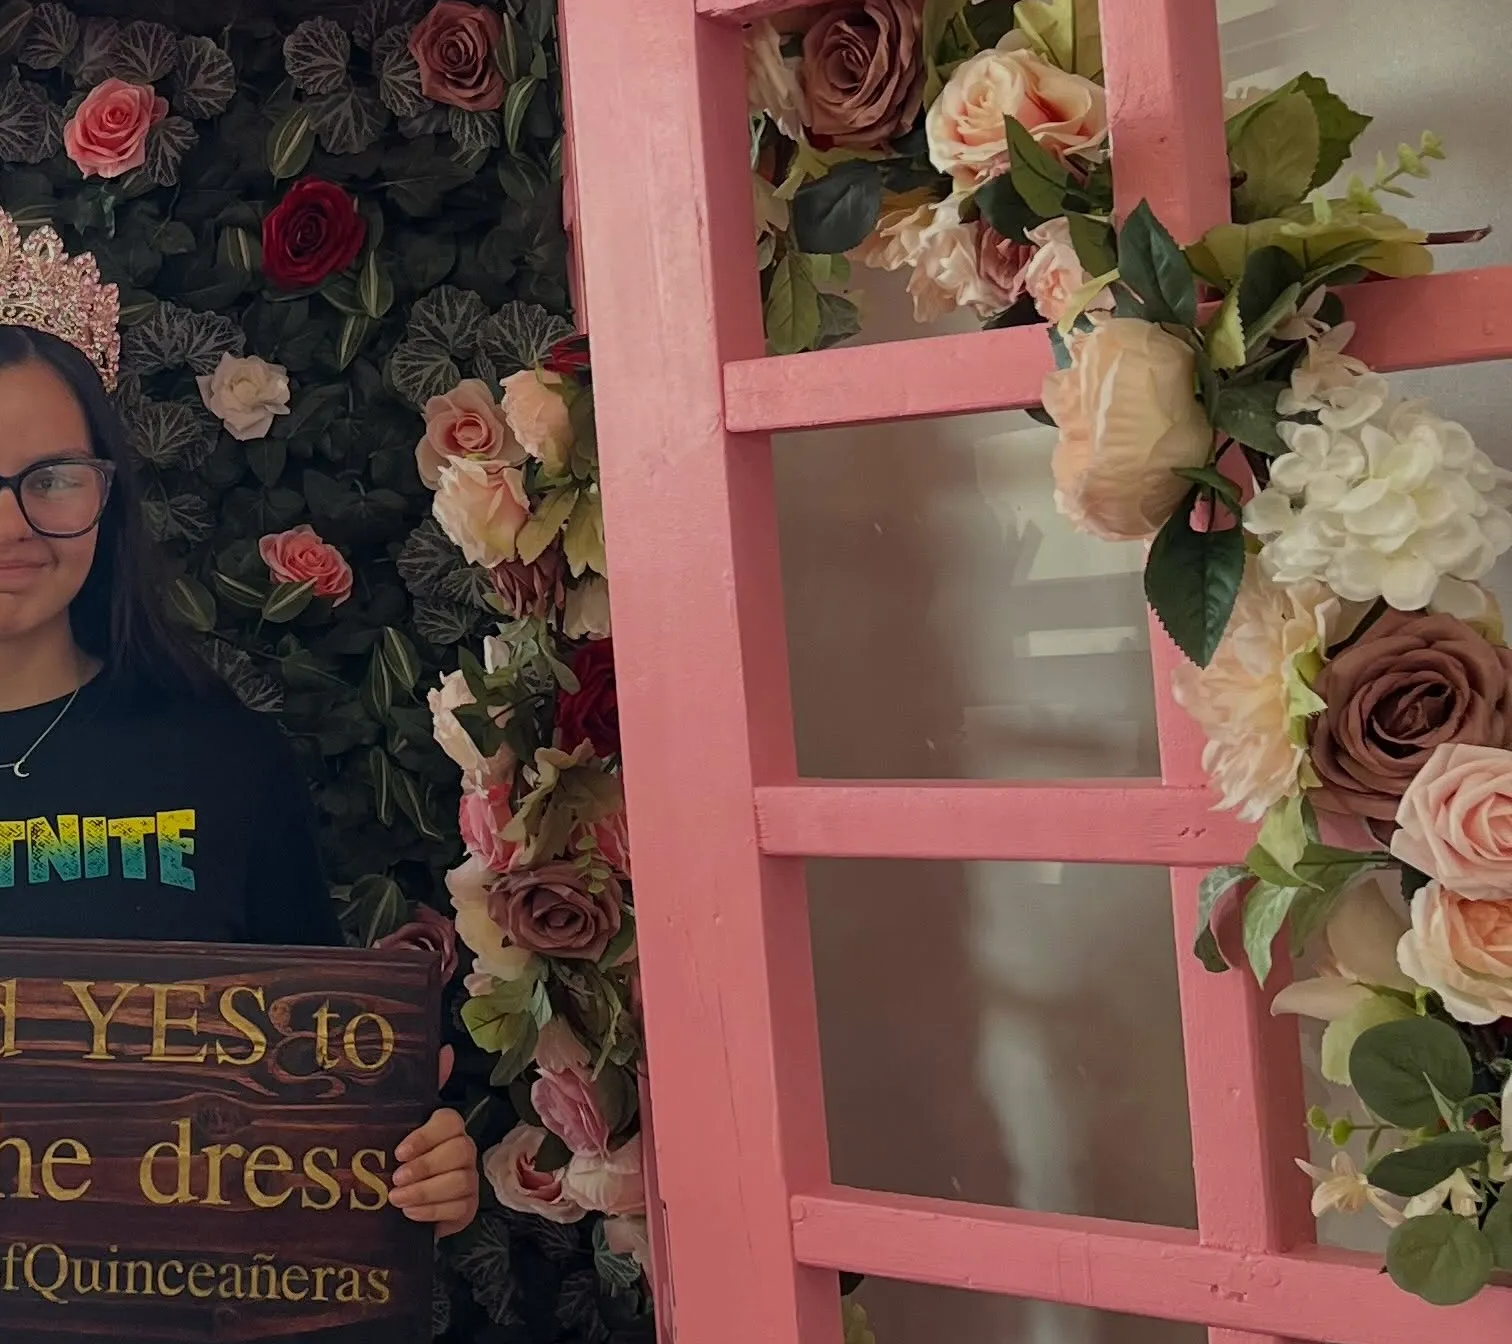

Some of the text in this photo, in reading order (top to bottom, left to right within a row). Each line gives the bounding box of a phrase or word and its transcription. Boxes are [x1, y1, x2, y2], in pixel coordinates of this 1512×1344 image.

[63, 978, 268, 1067] YES
[314, 998, 395, 1072] to
[138, 1118, 392, 1213] dress
